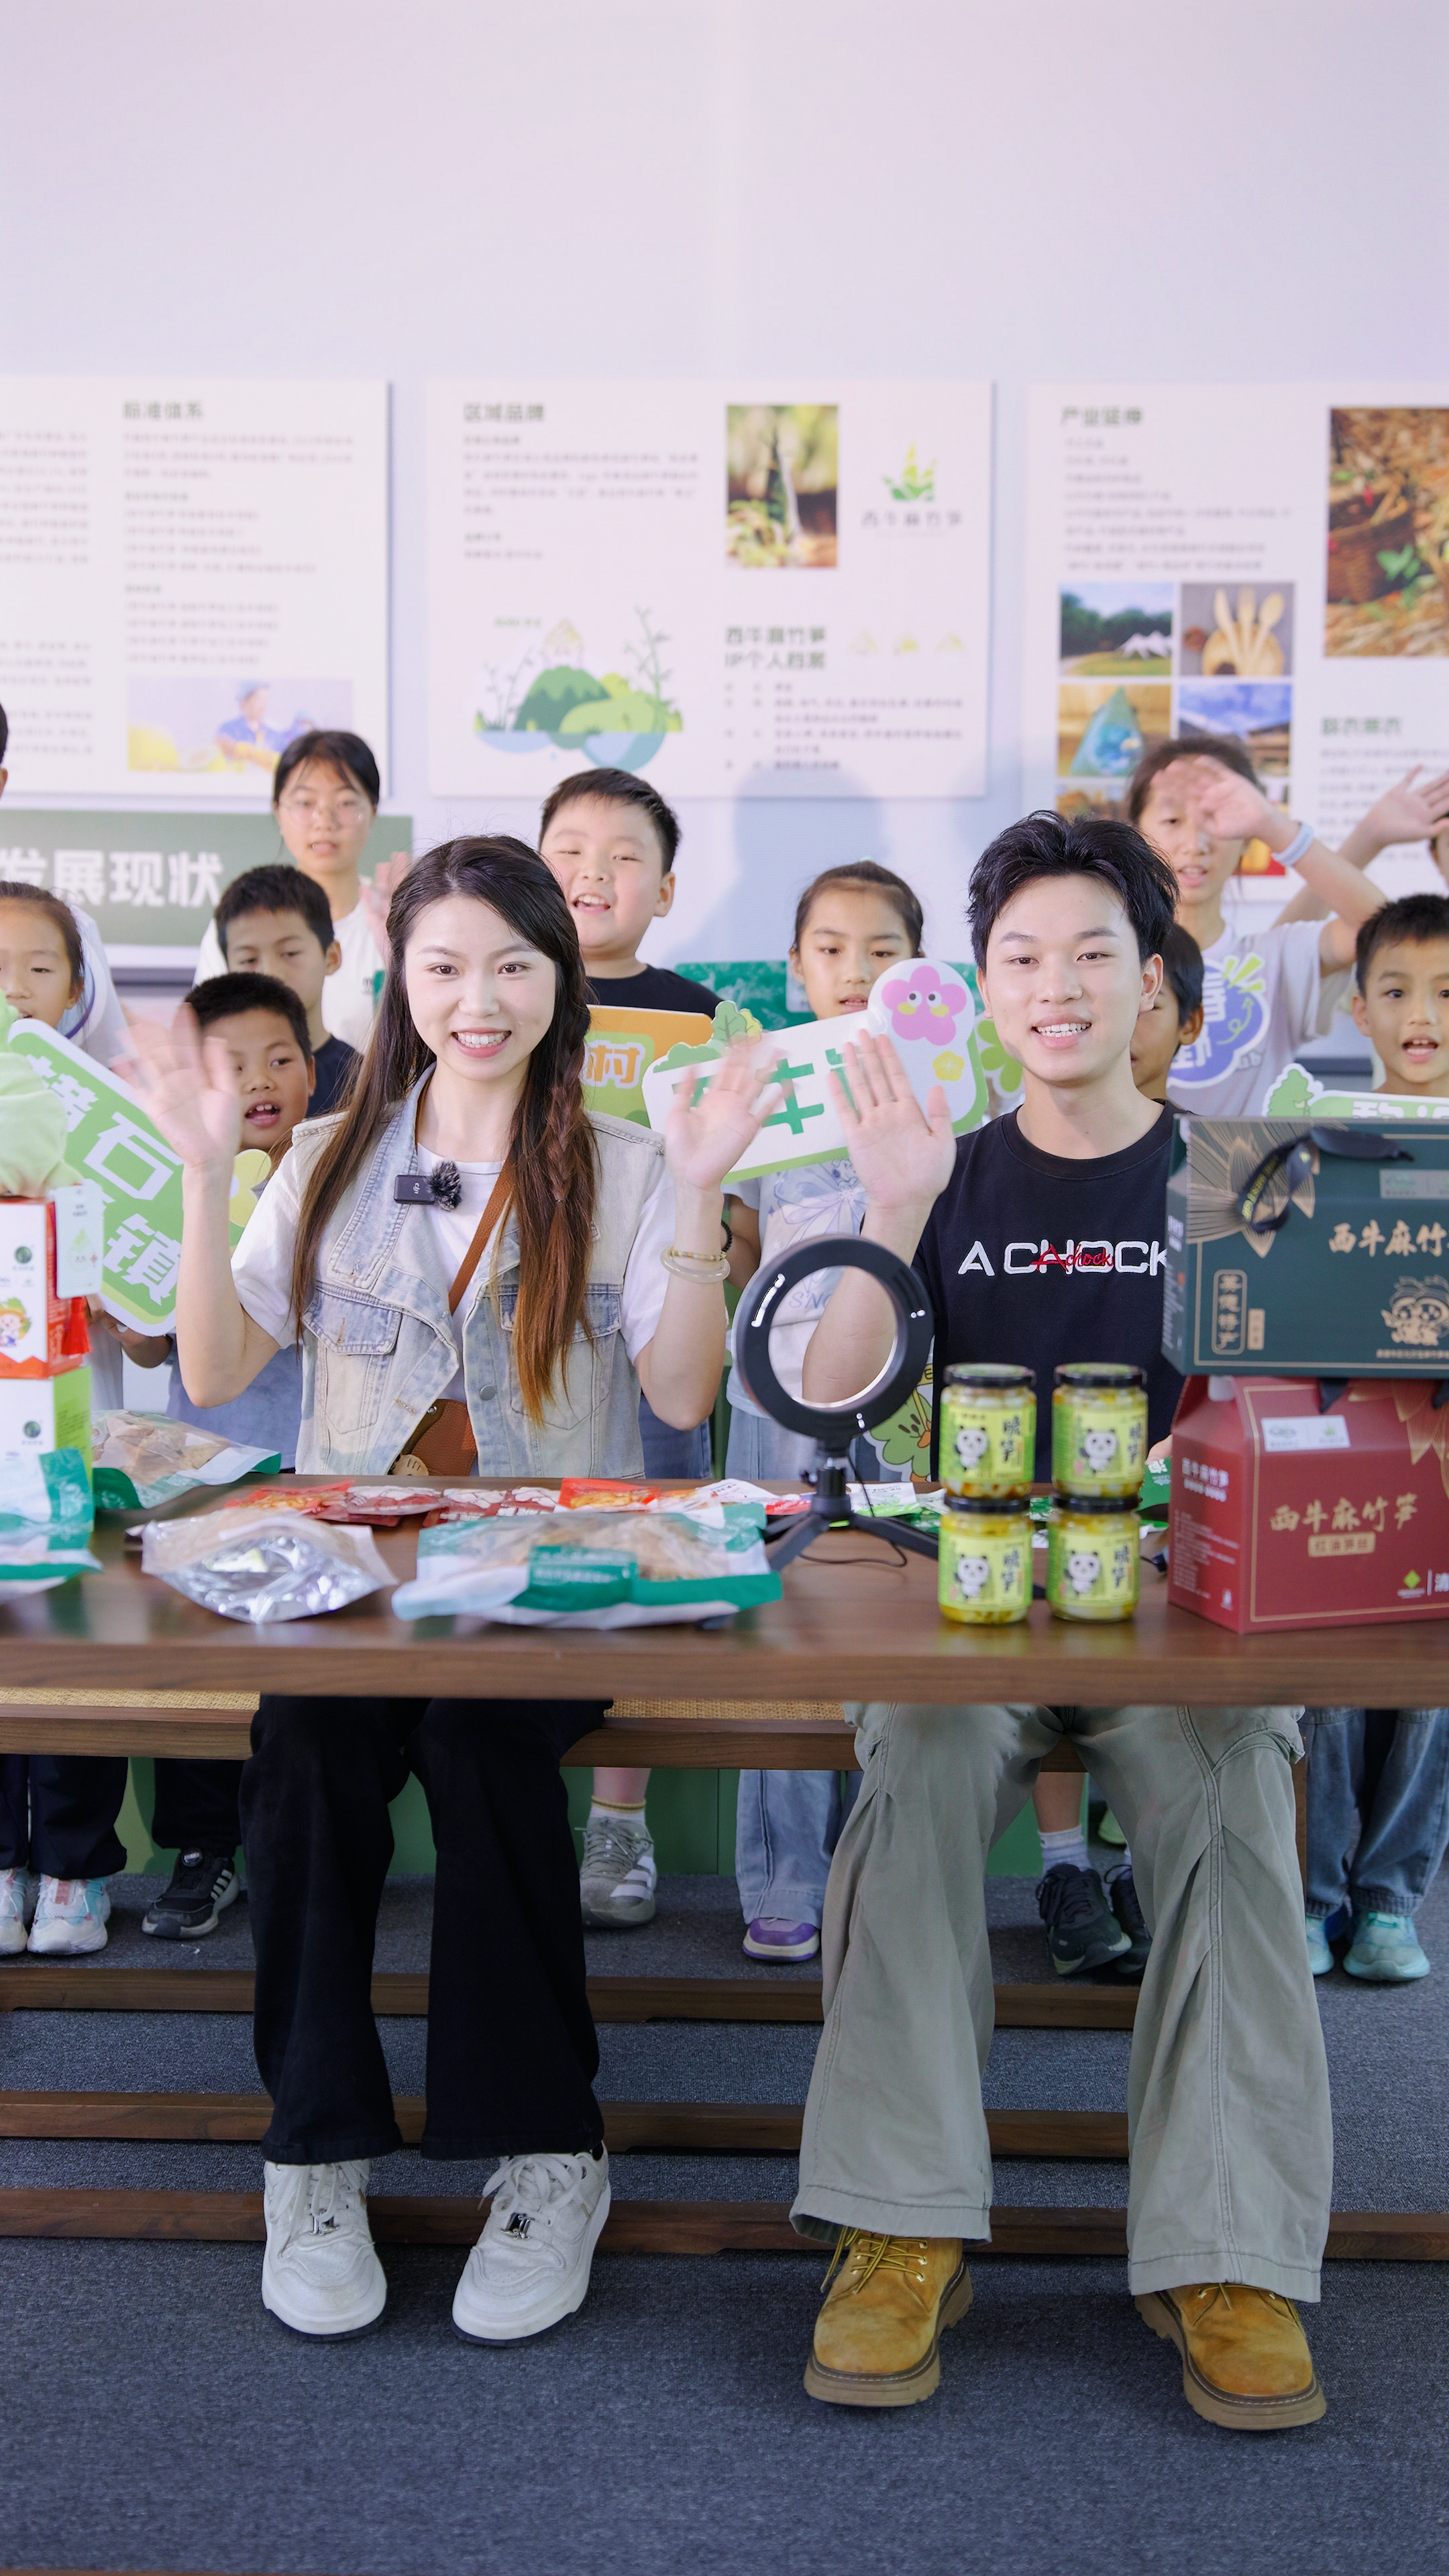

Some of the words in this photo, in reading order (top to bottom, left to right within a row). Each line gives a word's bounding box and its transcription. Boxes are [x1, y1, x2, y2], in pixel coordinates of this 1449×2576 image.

[124, 400, 203, 421] 标准体系
[464, 402, 544, 421] 区域品牌
[1061, 406, 1143, 426] 产业延伸
[725, 627, 825, 645] 西牛麻竹笋
[1328, 1219, 1449, 1257] 西牛麻竹
[1270, 1492, 1417, 1534] 西牛麻竹笋
